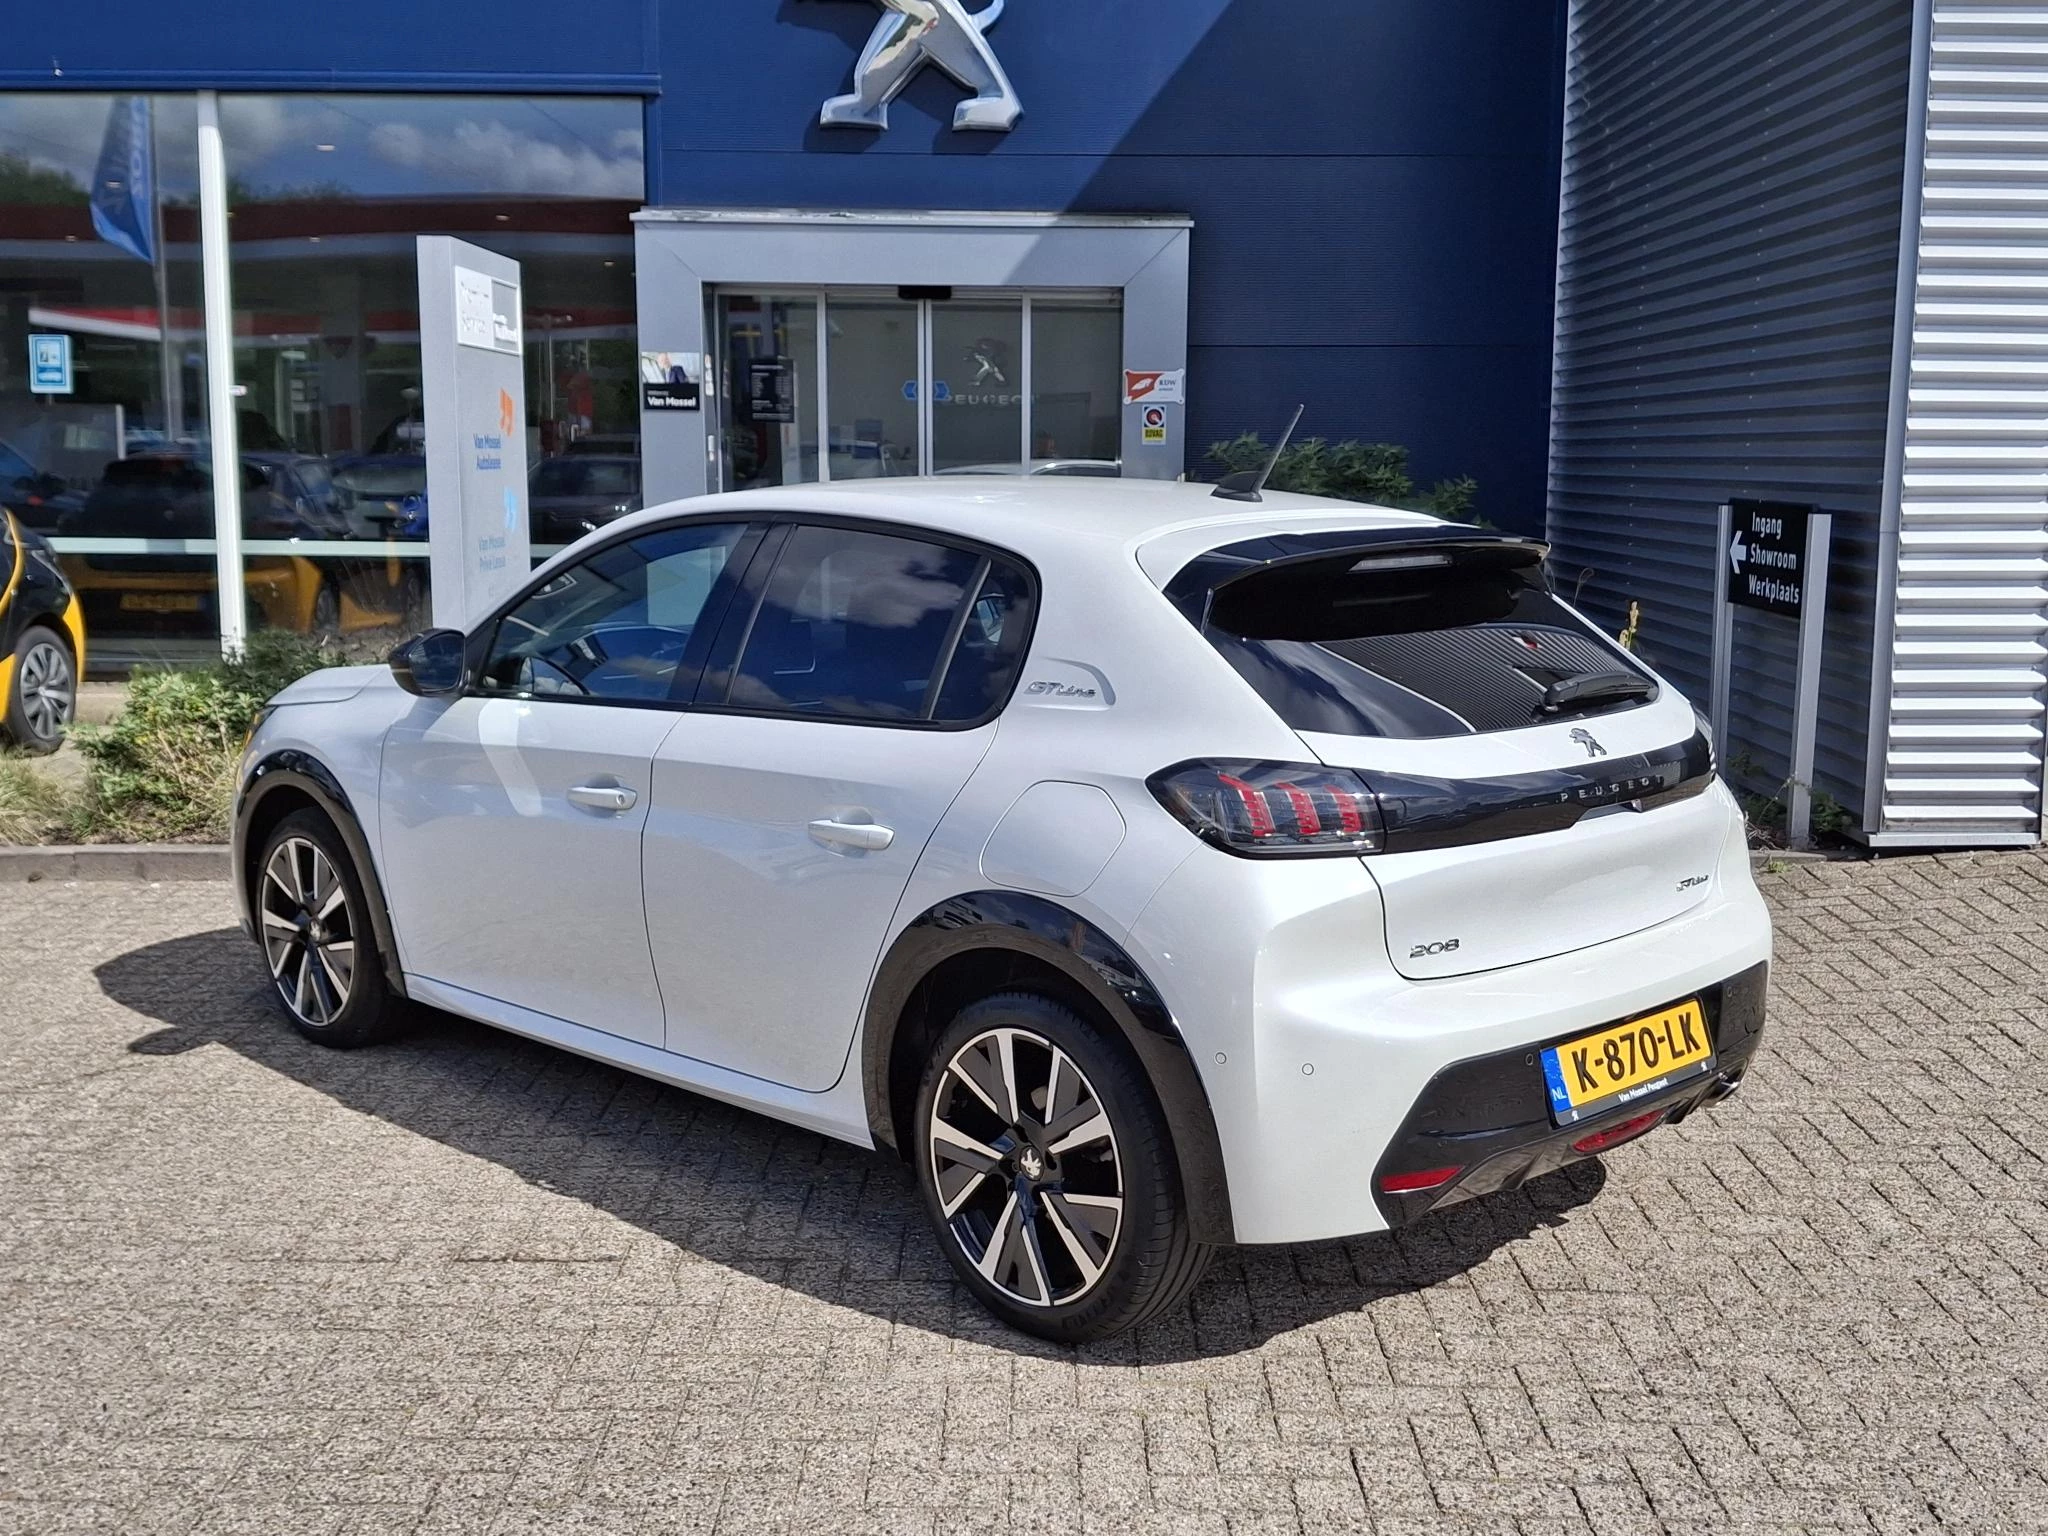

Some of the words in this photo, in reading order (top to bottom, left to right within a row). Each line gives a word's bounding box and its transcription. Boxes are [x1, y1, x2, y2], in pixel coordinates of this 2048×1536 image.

[647, 396, 664, 407] Van
[665, 396, 696, 407] Mossel
[1751, 511, 1782, 540] Ingang
[1750, 543, 1797, 570] Showroom
[1748, 573, 1800, 604] Werkplaats
[1560, 775, 1664, 802] PEUGEOT
[1409, 938, 1460, 958] 208
[1571, 1011, 1701, 1093] K-870-LK
[1552, 1087, 1567, 1101] NL
[1618, 1092, 1630, 1102] Van
